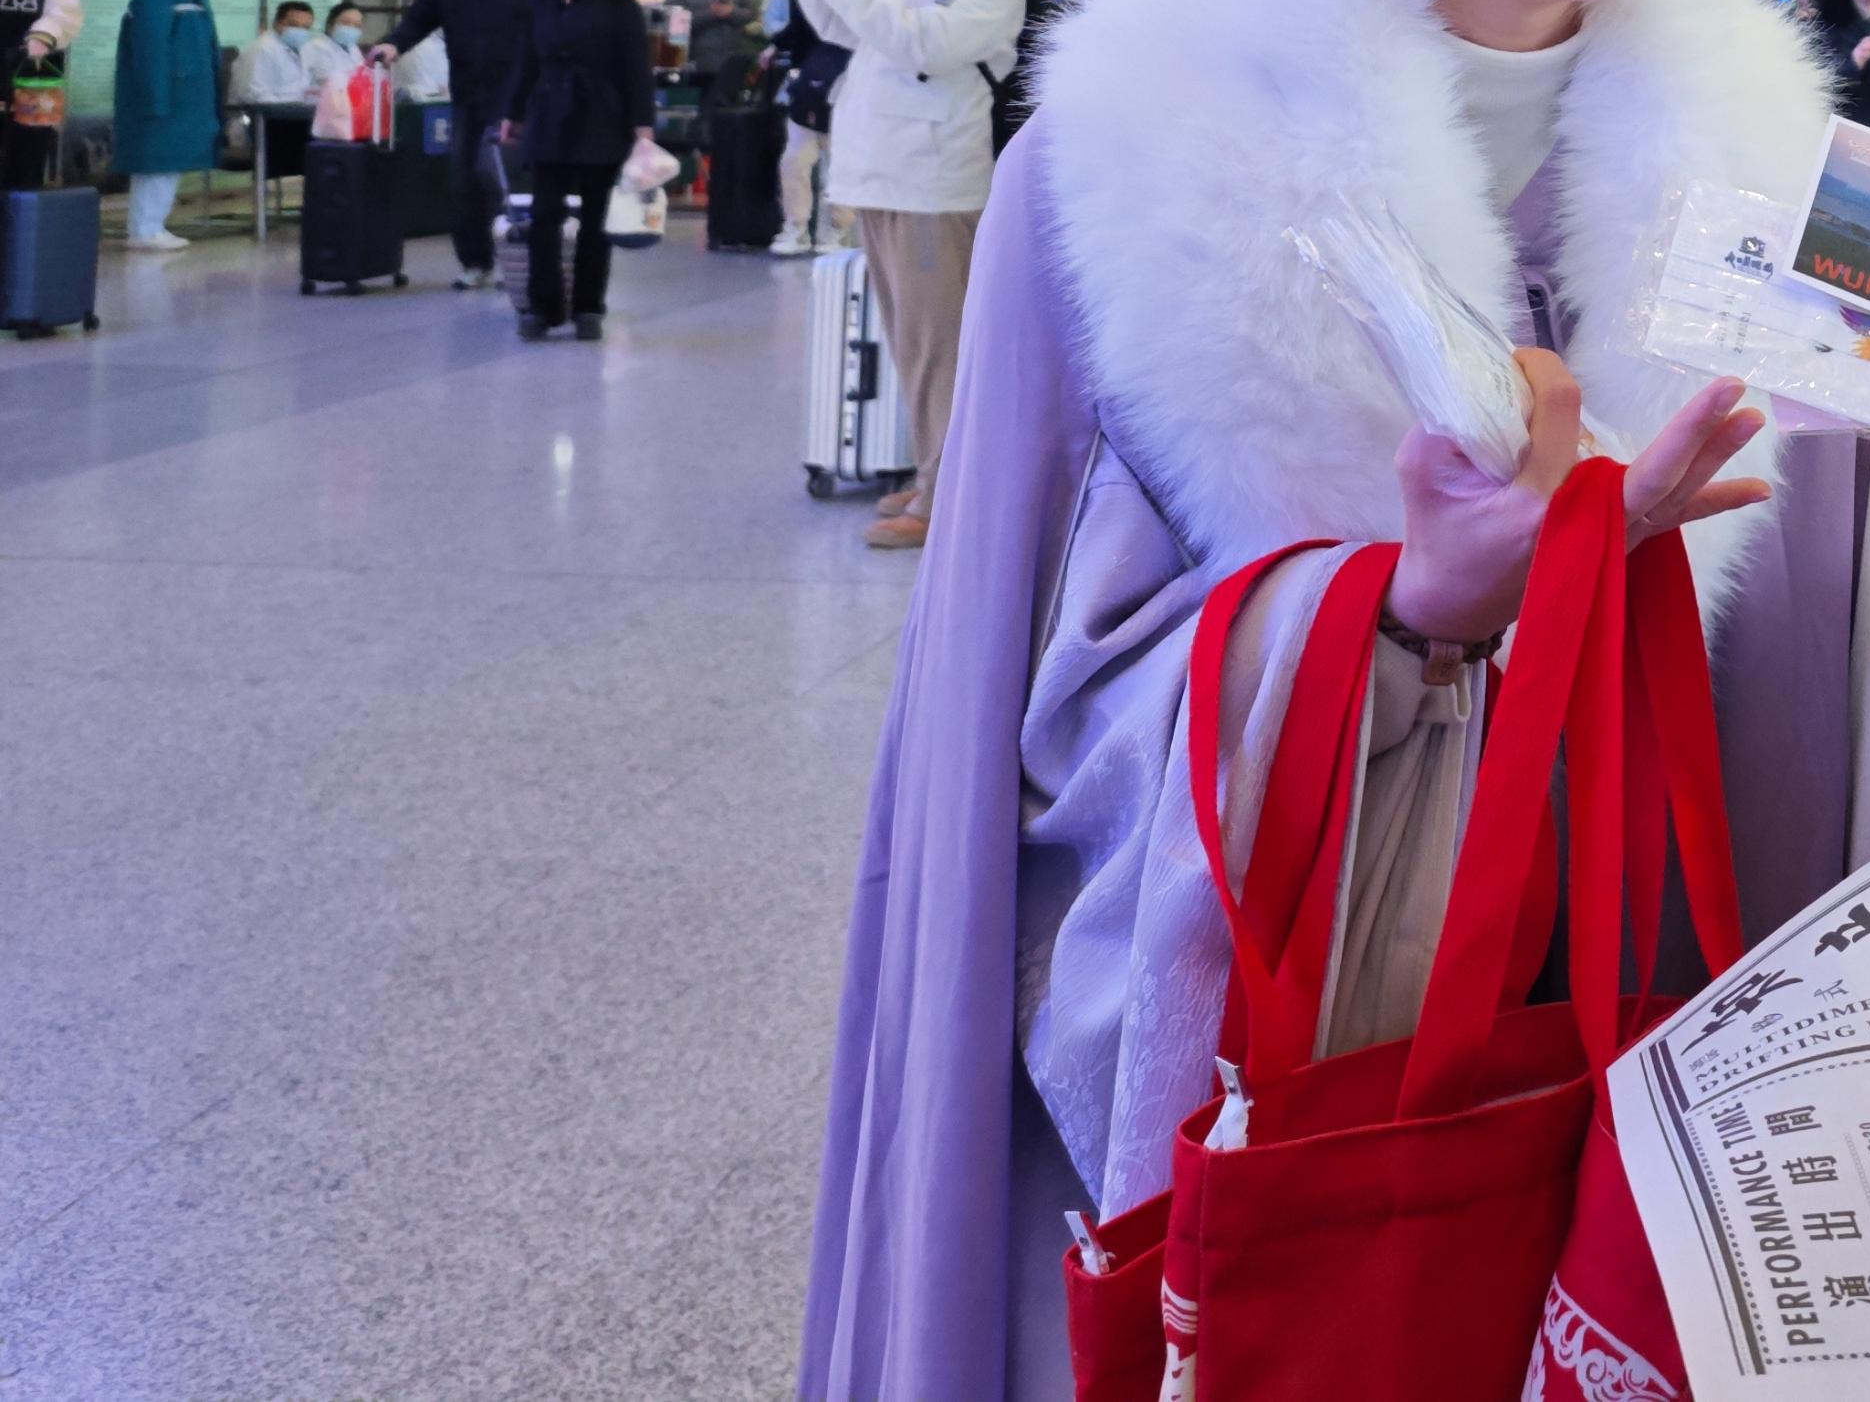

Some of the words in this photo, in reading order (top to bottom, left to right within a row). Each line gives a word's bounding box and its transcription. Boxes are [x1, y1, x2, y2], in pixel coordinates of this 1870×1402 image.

[1700, 1024, 1856, 1093] DRIFTING
[1711, 1102, 1757, 1150] TIME
[1729, 1150, 1826, 1346] PERFORMANCE
